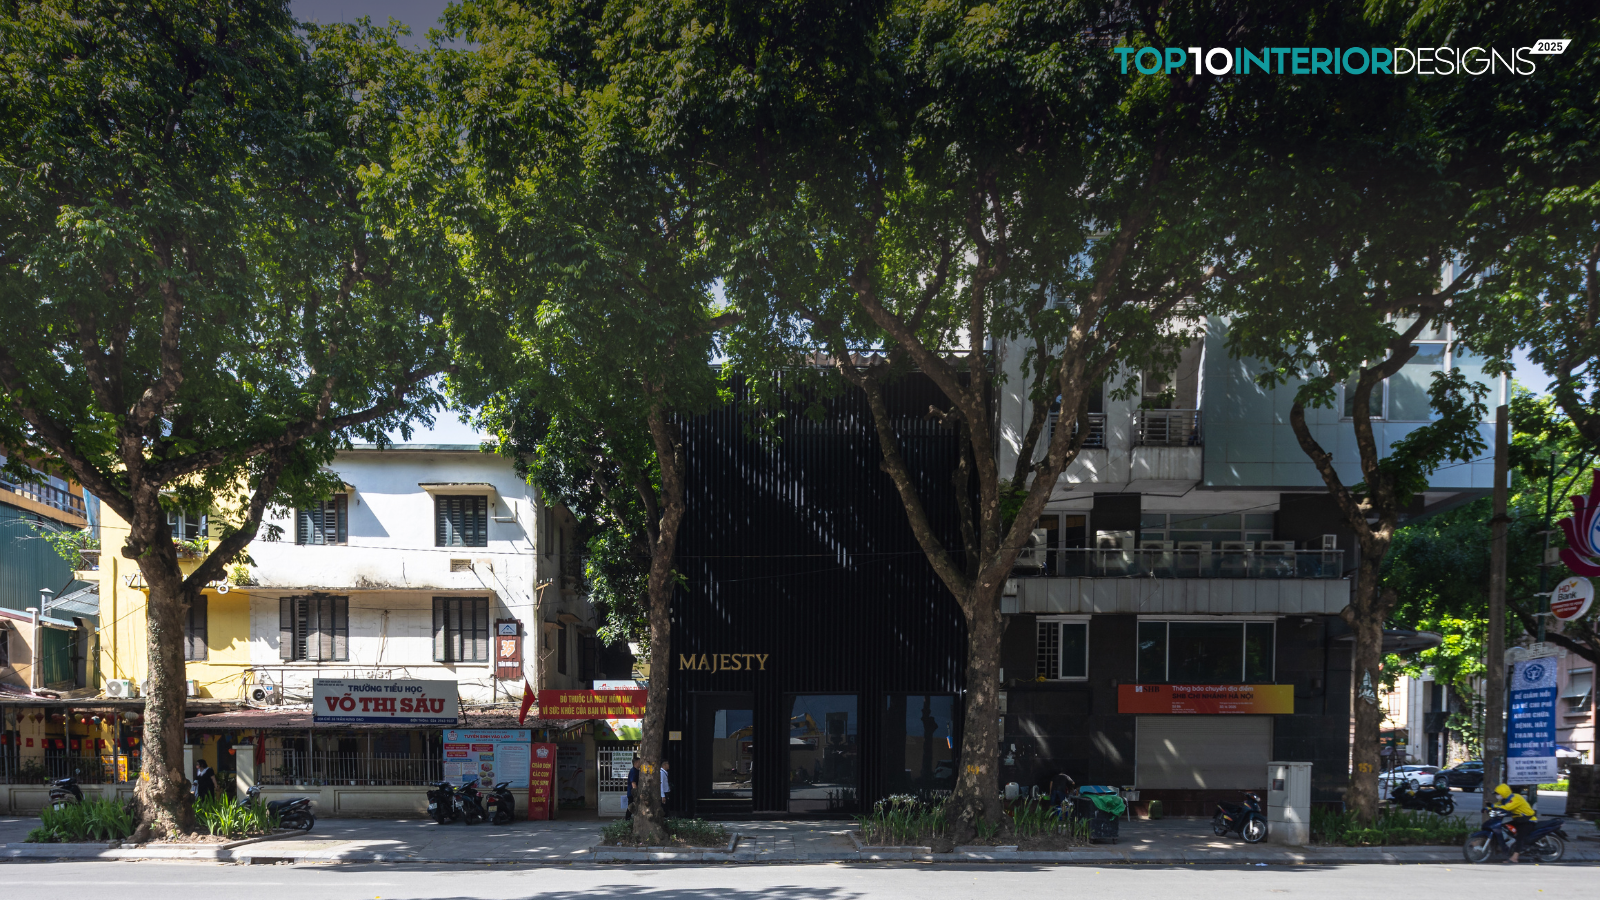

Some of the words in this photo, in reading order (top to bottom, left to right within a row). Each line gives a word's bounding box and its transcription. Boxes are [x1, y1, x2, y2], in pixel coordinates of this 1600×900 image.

[1558, 584, 1570, 593] HD
[1558, 591, 1577, 601] Bank
[500, 640, 516, 658] 35
[679, 653, 769, 674] MAJESTY
[348, 682, 382, 692] TRƯỜNG
[384, 682, 403, 693] TIỂU
[405, 686, 423, 695] HỌC
[1205, 684, 1227, 692] chuyển
[1227, 685, 1238, 693] địa
[560, 693, 567, 703] BỎ
[568, 693, 586, 703] THUỐC
[586, 693, 593, 703] LÁ
[594, 695, 608, 703] NGAY
[609, 694, 622, 703] HÔM
[622, 695, 633, 703] NAY
[1240, 692, 1254, 700] NỘI
[325, 693, 356, 712] VÕ
[359, 697, 397, 716] THỊ
[400, 693, 445, 713] SÁU
[542, 705, 548, 715] VÌ
[549, 705, 560, 715] SỨC
[576, 704, 587, 715] CỦA
[588, 706, 599, 717] BẠN
[600, 704, 607, 715] VÀ
[608, 705, 624, 715] NGƯỜI
[625, 705, 639, 715] THÂN
[1358, 763, 1372, 773] 151
